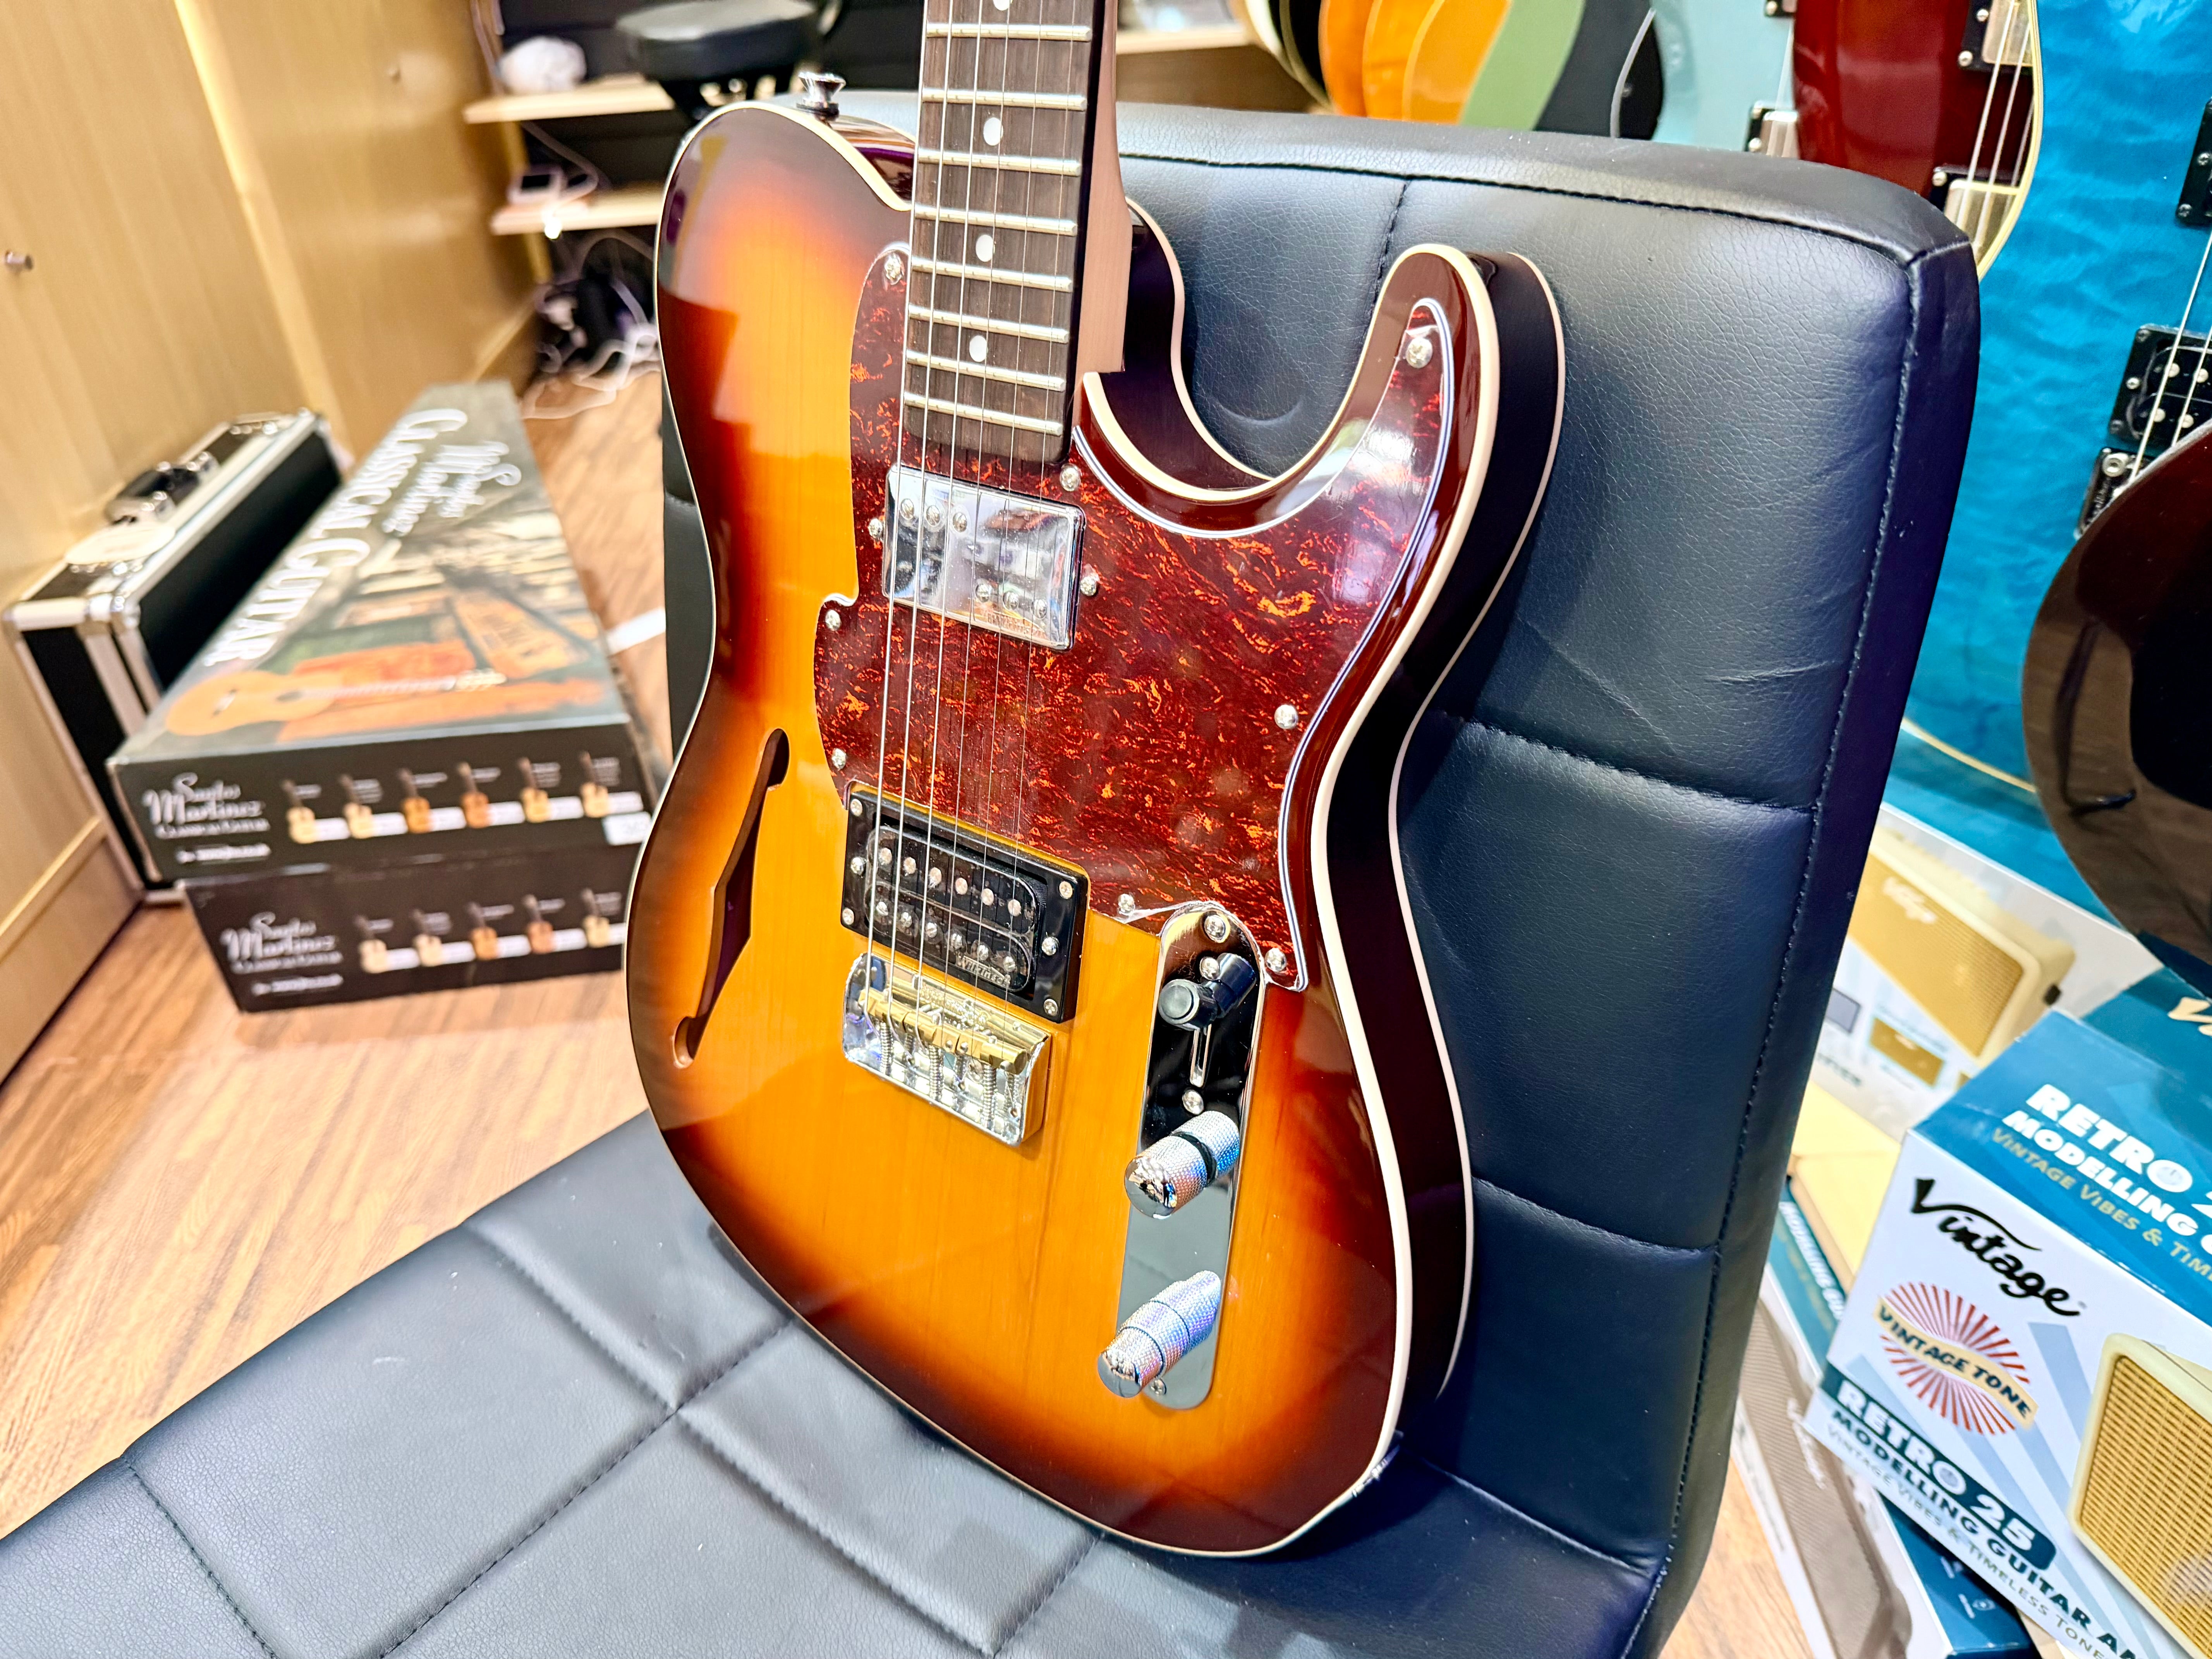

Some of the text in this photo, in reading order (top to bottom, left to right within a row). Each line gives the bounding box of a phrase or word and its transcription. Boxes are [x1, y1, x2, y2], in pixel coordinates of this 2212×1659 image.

[2002, 1110, 2198, 1236] MODELLING
[2026, 1084, 2193, 1192] RETRO
[1910, 1177, 2081, 1317] Vintage
[1991, 1127, 2076, 1190] VINTAGE
[2080, 1183, 2140, 1230] VIBES
[2142, 1228, 2163, 1247] &
[2170, 1241, 2212, 1283] TIM
[1879, 1304, 2032, 1419] VINTAGE TONE
[1832, 1410, 1979, 1535] MODELLING
[1986, 1538, 2092, 1630] GUITAR
[1837, 1379, 1967, 1496] RETRO
[1970, 1494, 2035, 1551] 25
[1968, 1542, 2048, 1618] TIMELESS
